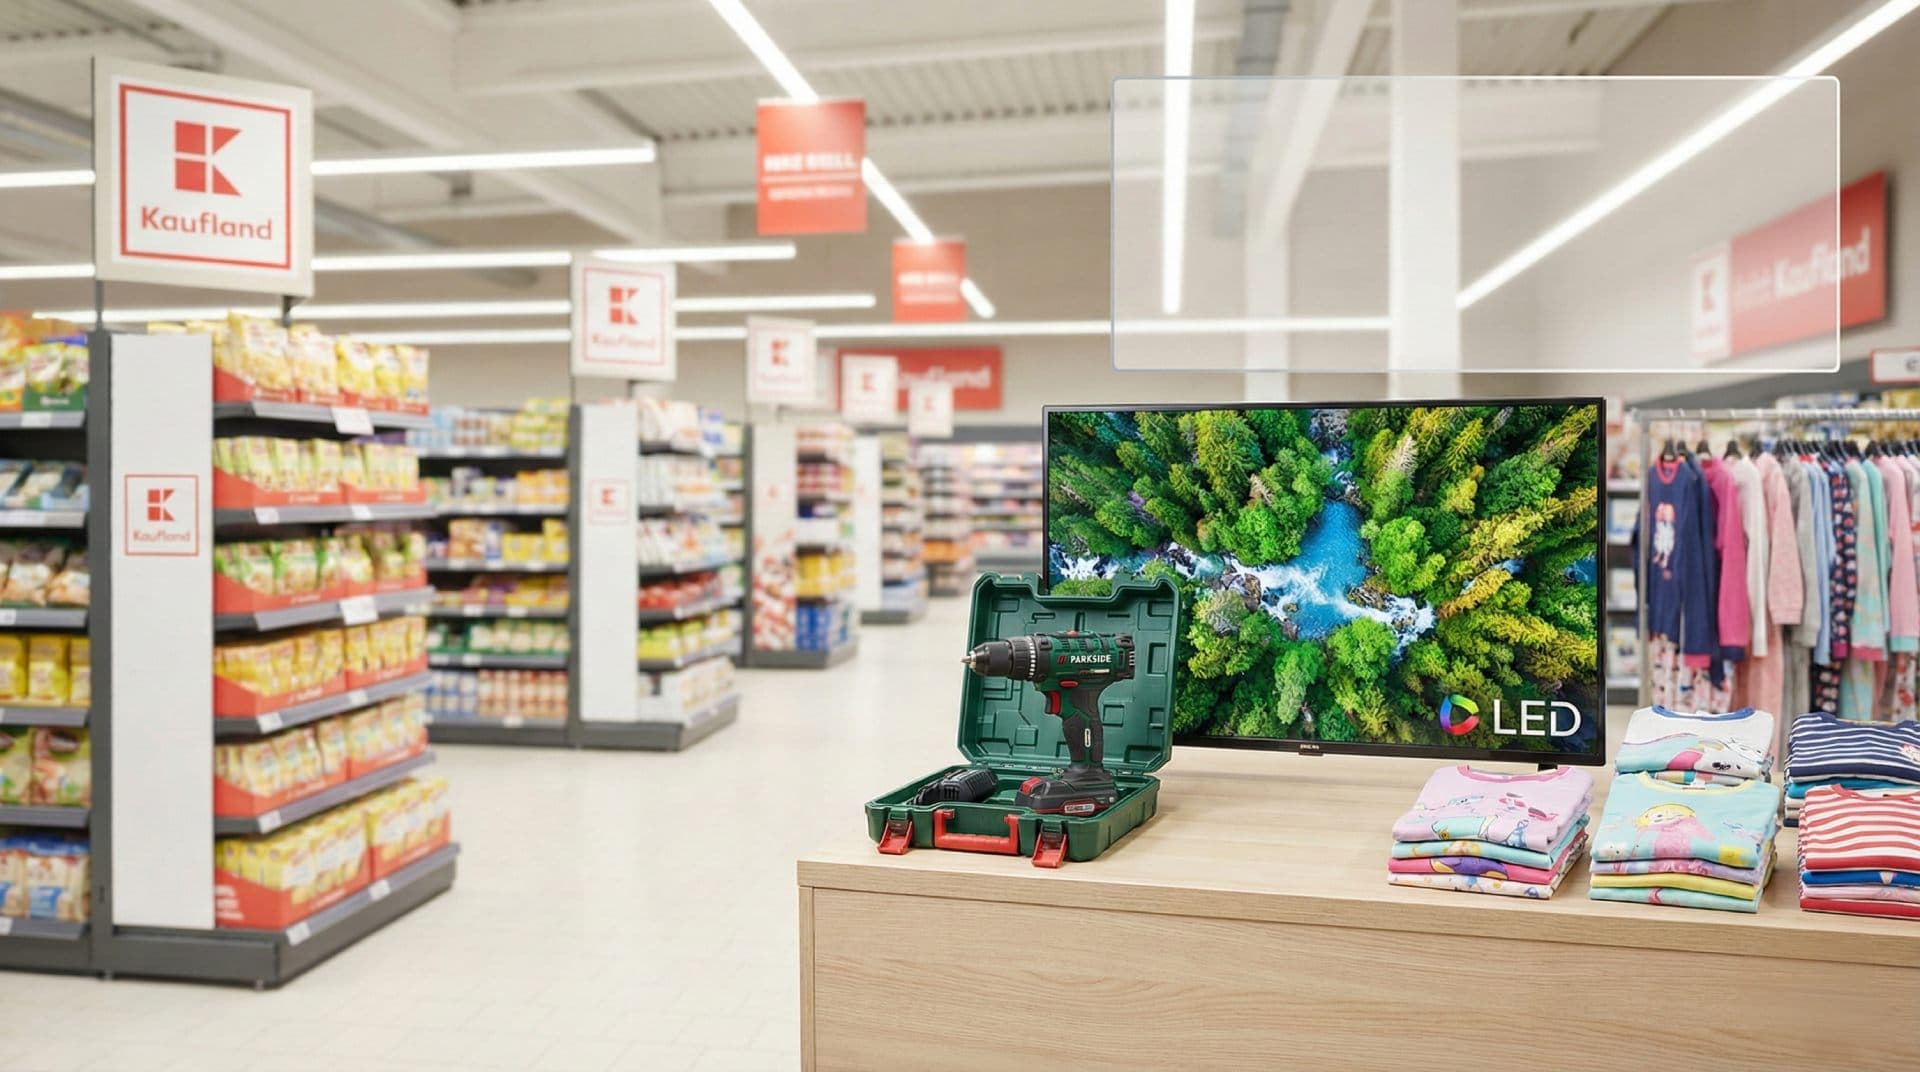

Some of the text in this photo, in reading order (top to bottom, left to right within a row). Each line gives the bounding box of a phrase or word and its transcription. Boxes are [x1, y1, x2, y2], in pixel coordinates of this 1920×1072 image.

[141, 204, 272, 240] Kaufland
[132, 530, 191, 542] Kaufland
[1070, 654, 1113, 664] PARKSIDE
